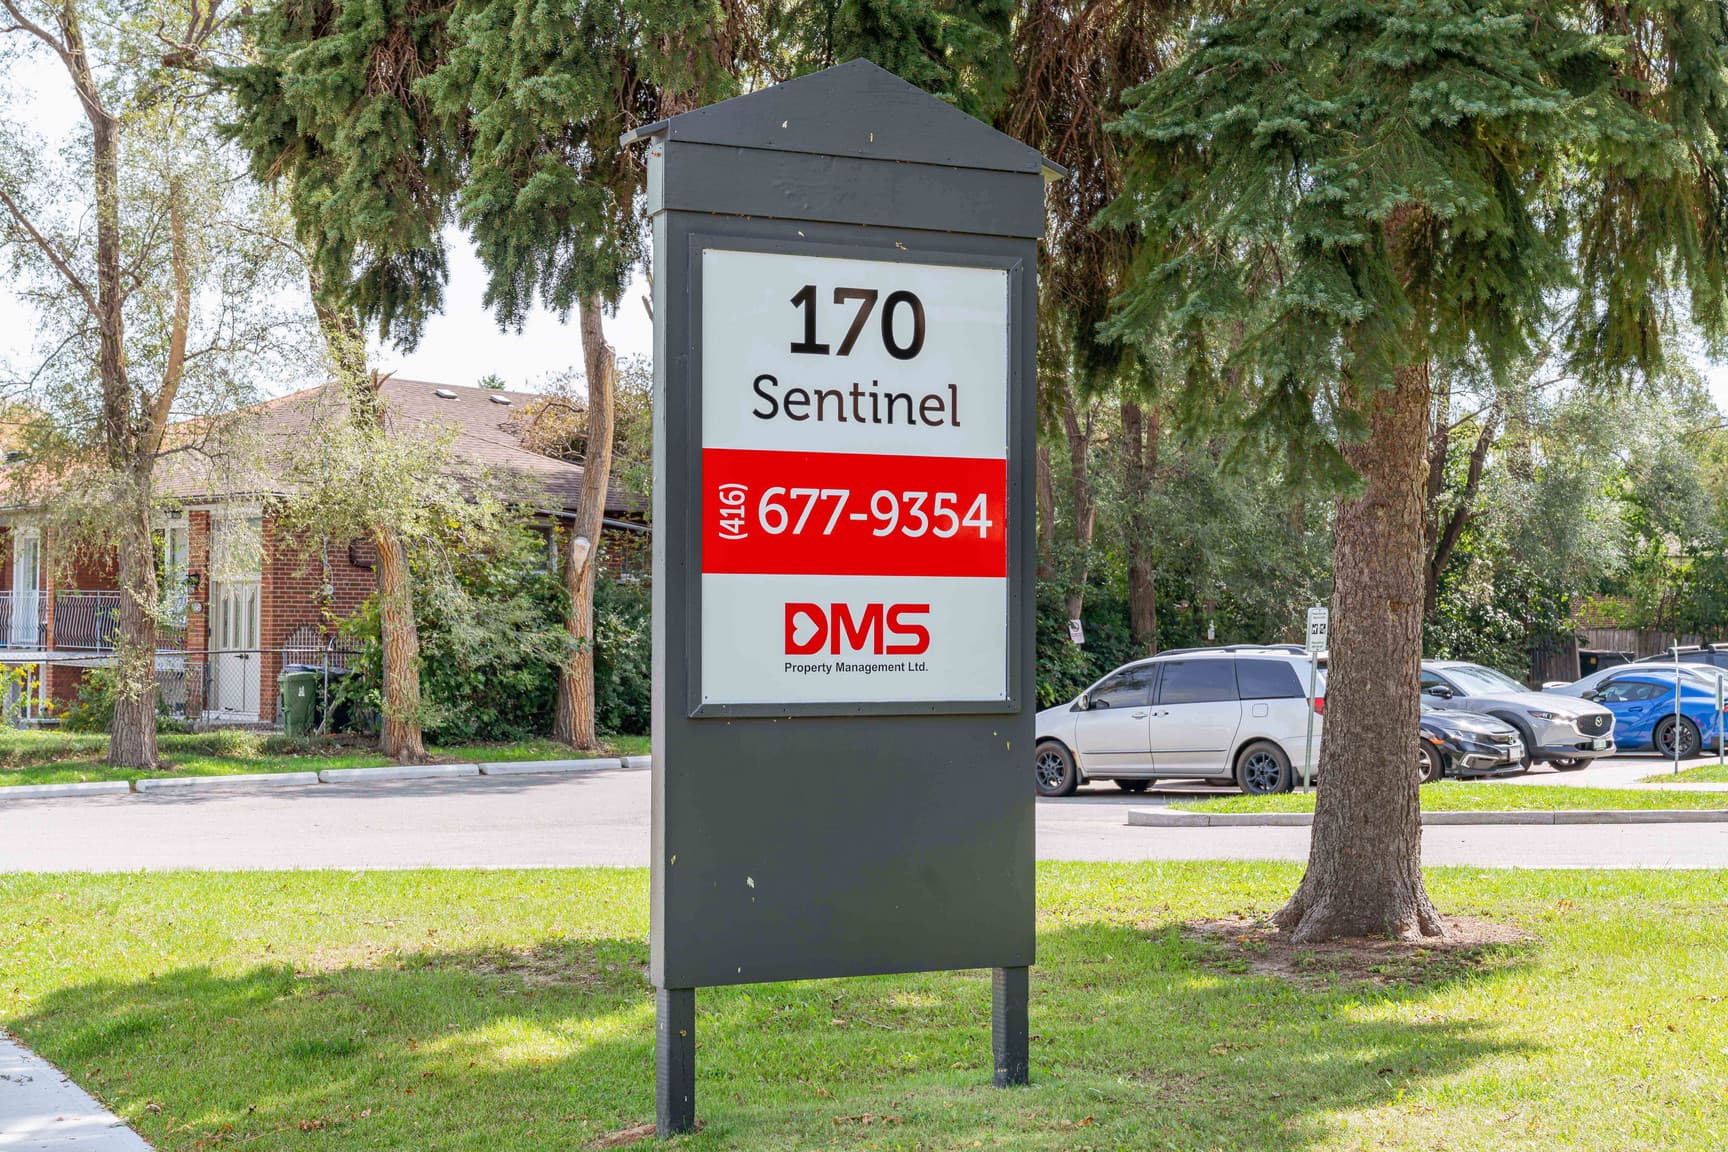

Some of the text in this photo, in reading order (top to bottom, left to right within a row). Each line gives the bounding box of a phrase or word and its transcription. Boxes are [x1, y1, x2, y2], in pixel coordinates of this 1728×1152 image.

[790, 285, 926, 361] 170
[752, 374, 961, 427] Sentinel
[718, 483, 749, 540] (416)
[758, 487, 993, 539] 677-9354
[785, 602, 931, 655] DMS
[784, 662, 929, 675] Property Management Ltd.
